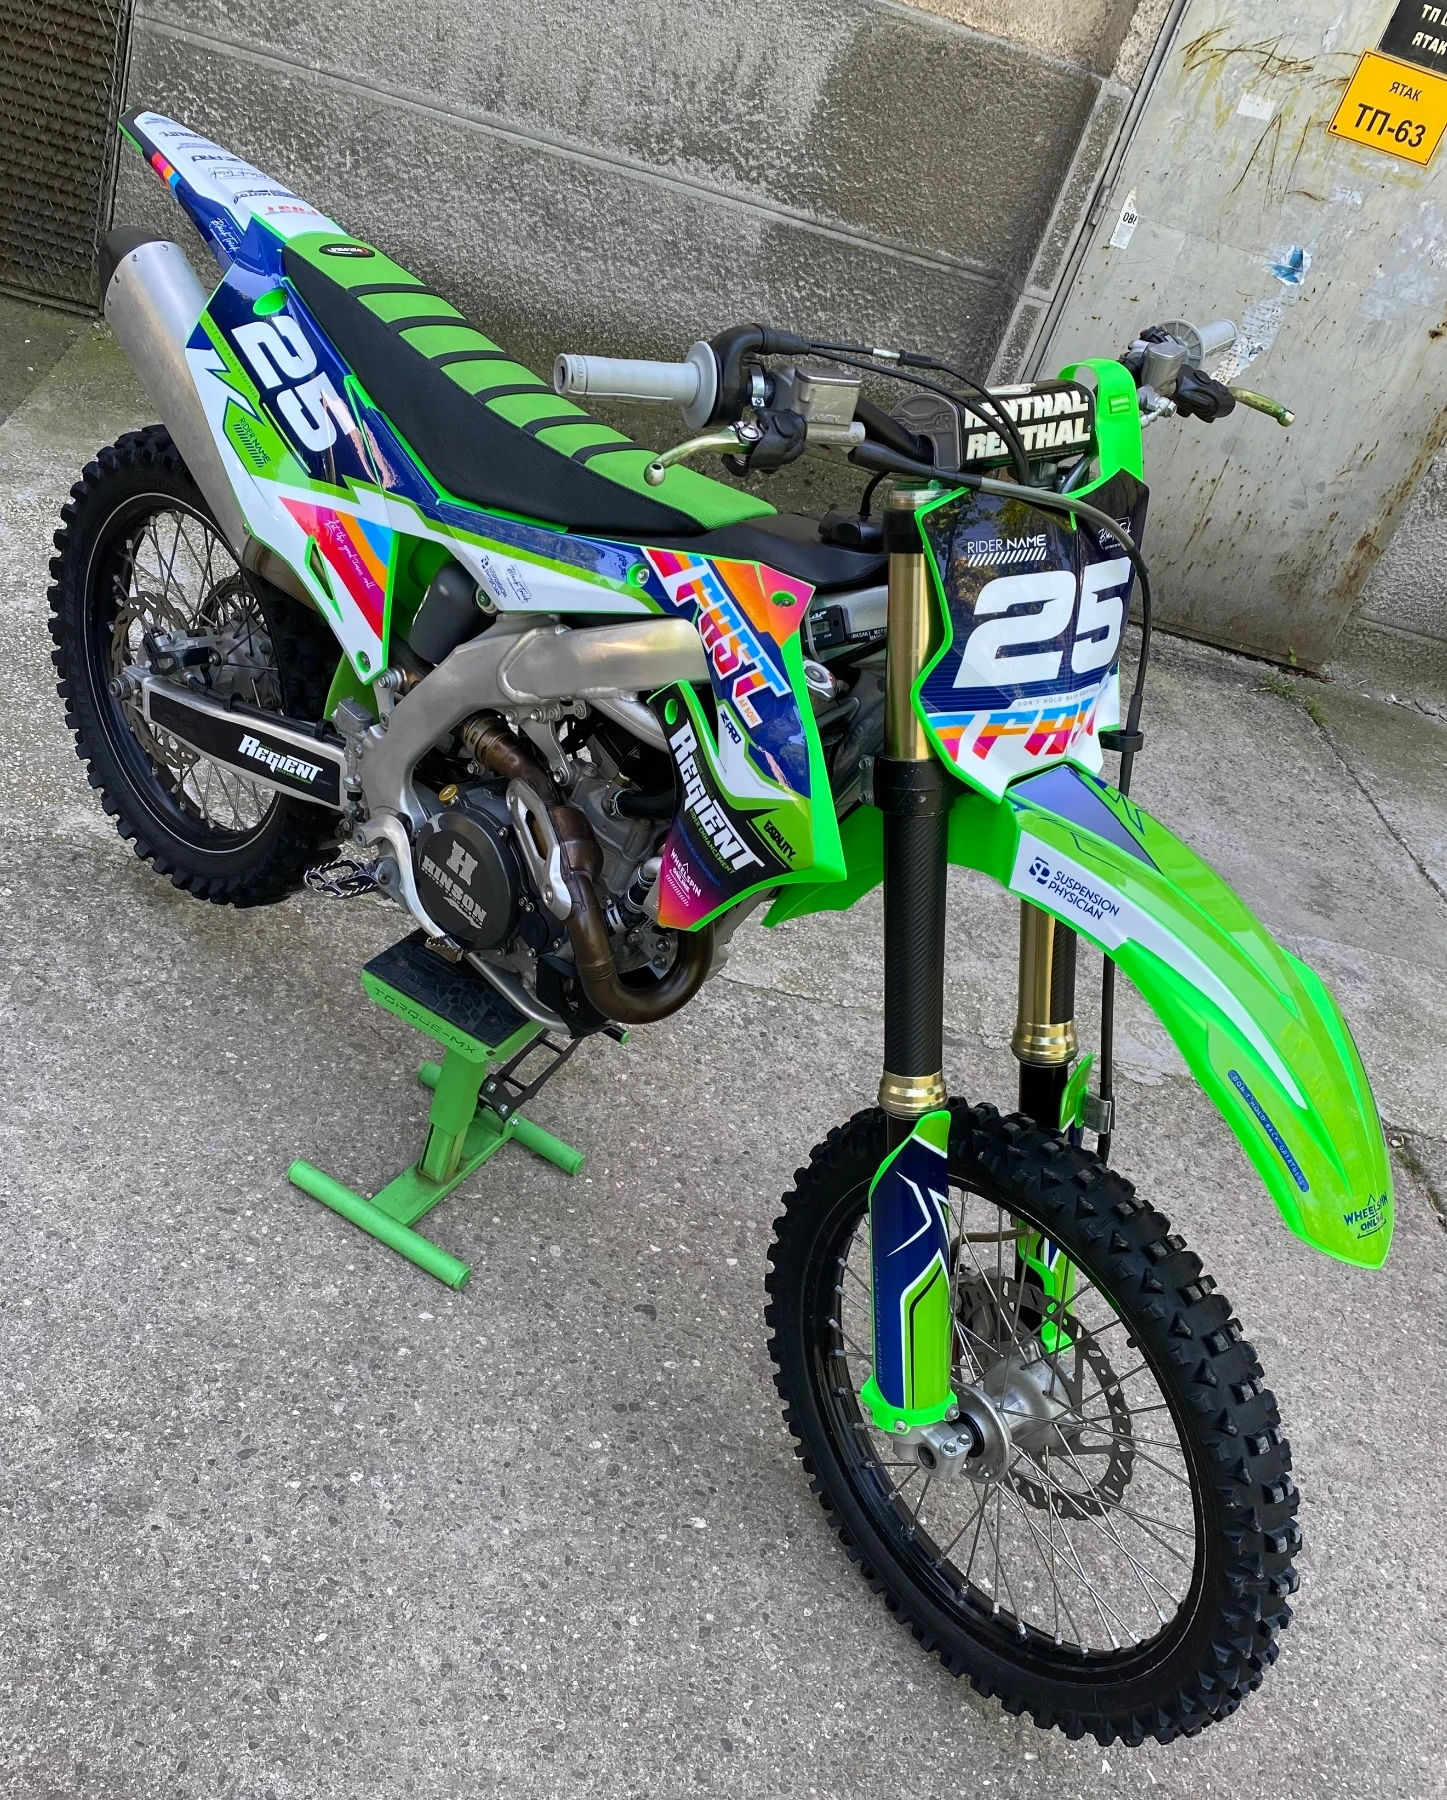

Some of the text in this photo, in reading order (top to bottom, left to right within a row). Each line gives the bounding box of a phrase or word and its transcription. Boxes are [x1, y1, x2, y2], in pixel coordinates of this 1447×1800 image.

[1421, 4, 1442, 24] ТП
[1389, 81, 1422, 101] ЯТАК
[1354, 103, 1426, 147] ТП-63
[231, 315, 357, 452] 25
[239, 417, 271, 464] RIDER NAME
[967, 534, 1047, 554] RIDER NAME
[672, 568, 792, 699] FAST
[952, 556, 1132, 688] 25
[446, 840, 478, 886] H
[688, 807, 736, 875] RIDER ENHANCEMENT
[421, 854, 487, 922] HINSON
[670, 848, 702, 898] WHEELSPIN
[1053, 871, 1120, 917] SUSPENSION
[1048, 881, 1103, 921] PHYSICIAN
[374, 987, 476, 1055] TORQUE-MX
[1232, 1075, 1305, 1187] DONT HOLD BACK GREATNESS
